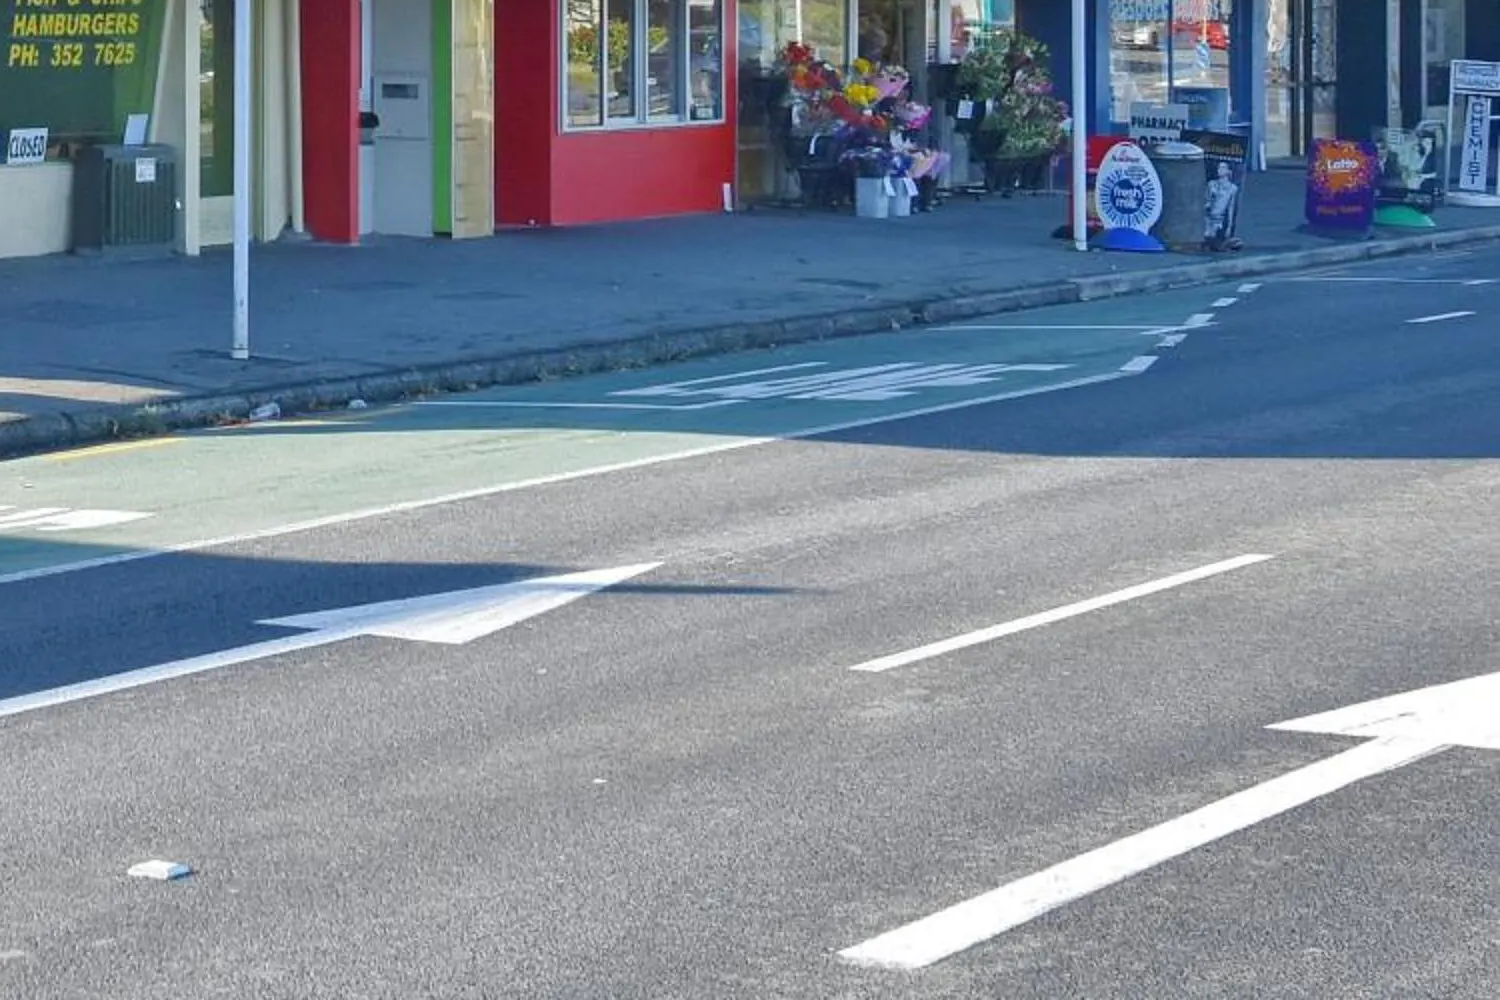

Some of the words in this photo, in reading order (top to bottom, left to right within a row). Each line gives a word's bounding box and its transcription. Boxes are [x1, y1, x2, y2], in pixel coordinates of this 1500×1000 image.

[12, 11, 141, 37] HAMBURGERS
[8, 42, 40, 68] PH:
[50, 42, 84, 67] 352
[94, 42, 136, 66] 7625
[1130, 116, 1188, 130] PHARMACY
[9, 135, 45, 159] CLOSED
[1468, 101, 1486, 185] CHEMIST
[1326, 158, 1360, 170] Lotto
